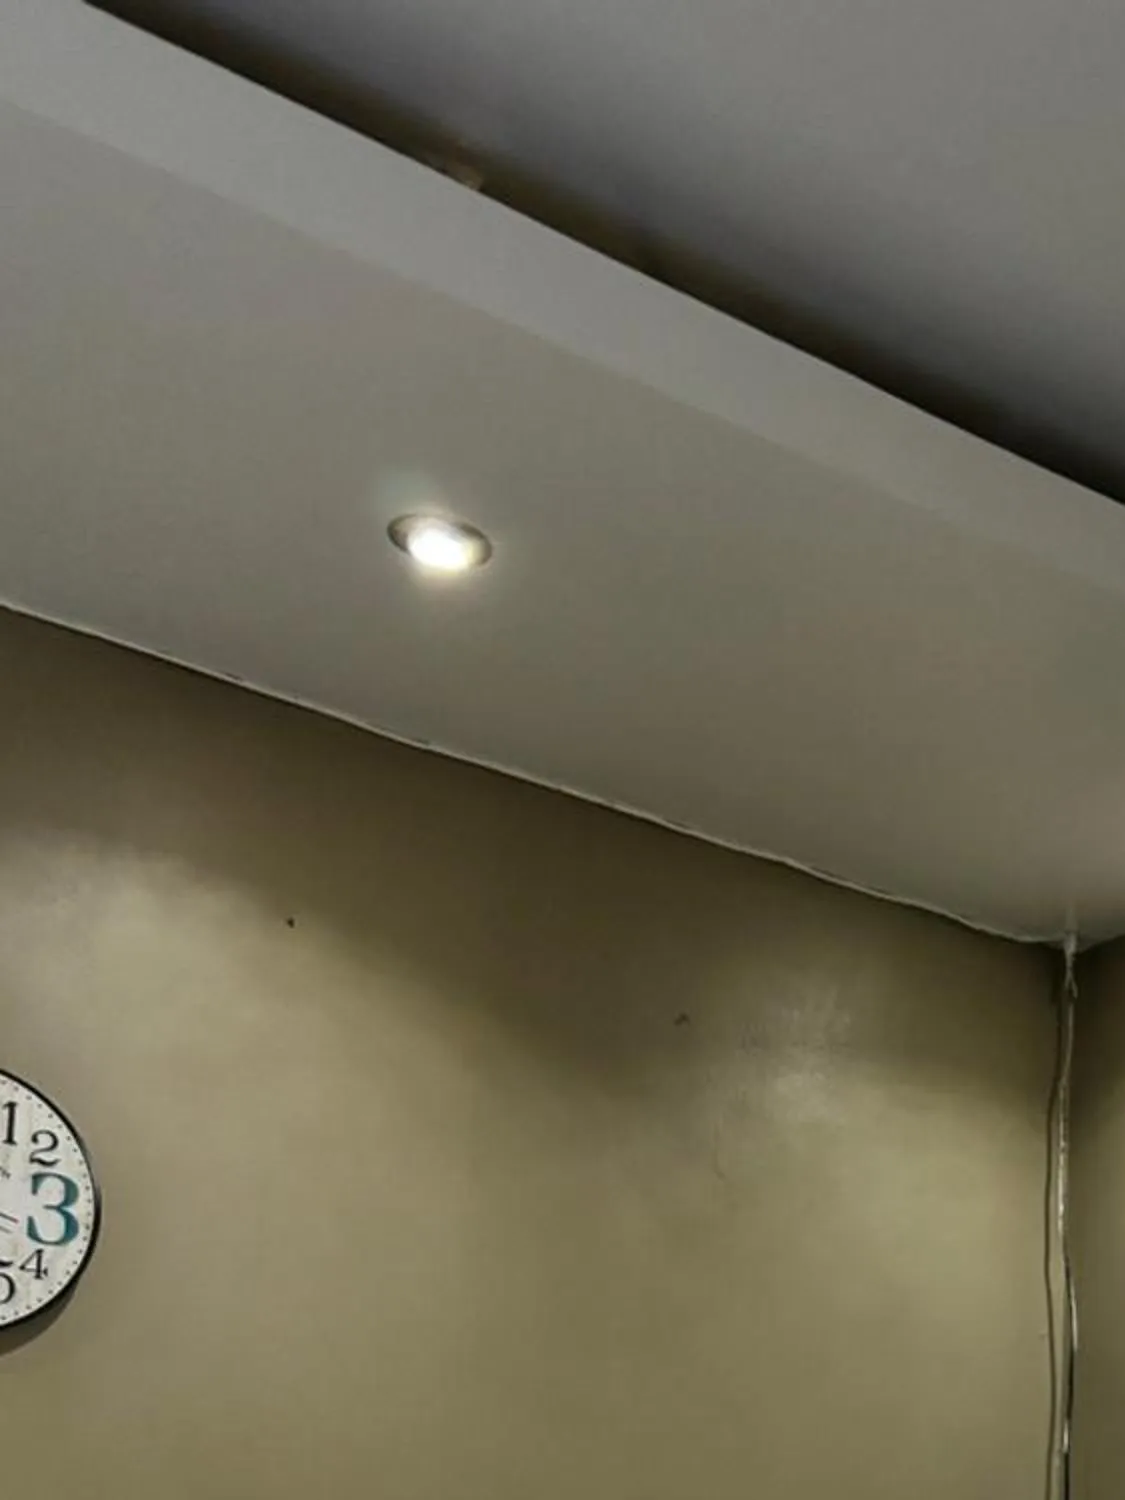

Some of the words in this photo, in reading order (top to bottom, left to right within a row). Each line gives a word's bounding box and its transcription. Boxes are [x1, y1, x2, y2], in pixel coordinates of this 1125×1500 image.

[30, 1130, 61, 1167] 2
[26, 1172, 81, 1247] 3
[19, 1248, 48, 1280] 4
